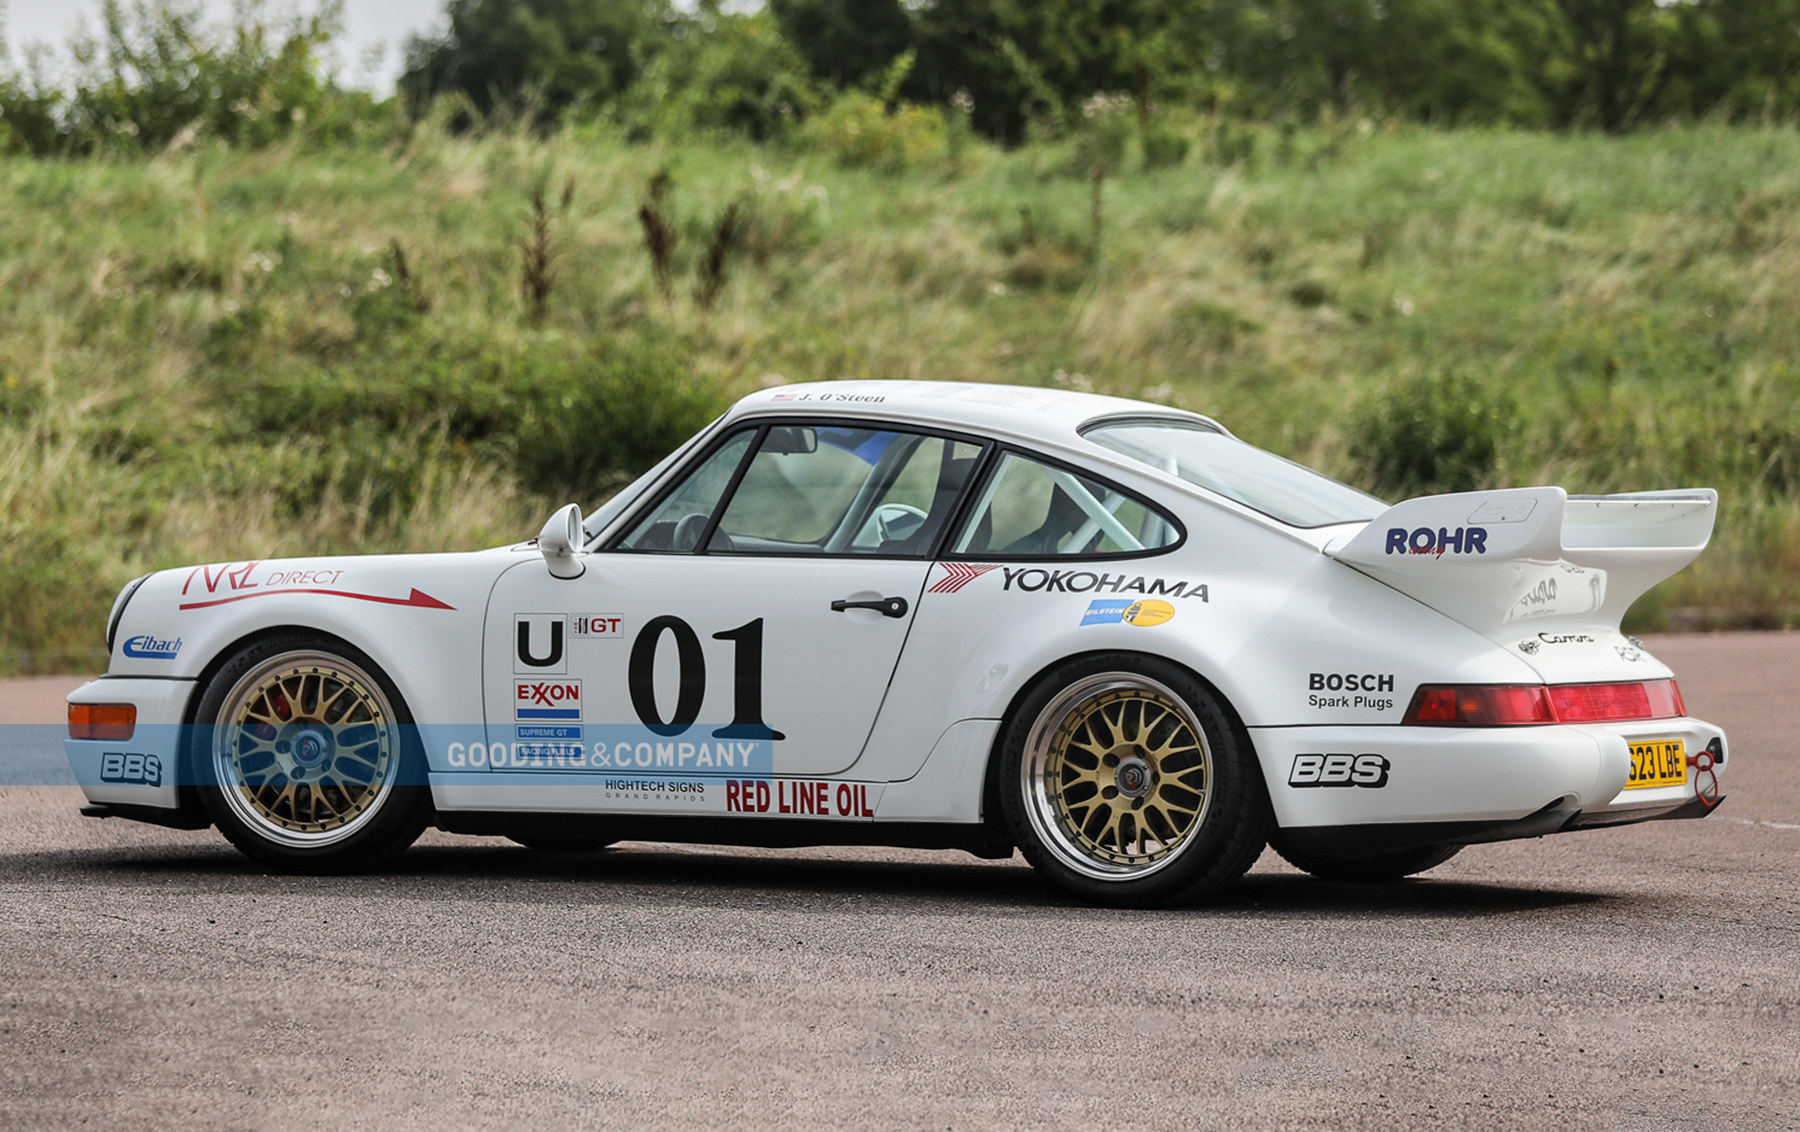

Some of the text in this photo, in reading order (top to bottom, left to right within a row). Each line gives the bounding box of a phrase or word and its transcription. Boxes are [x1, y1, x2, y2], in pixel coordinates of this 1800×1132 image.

[1385, 527, 1488, 555] ROHR
[265, 570, 344, 586] DIRECT
[1003, 567, 1209, 603] YOKOHAMA
[591, 618, 621, 633] GT
[123, 635, 183, 660] Eibach
[517, 621, 563, 667] U
[628, 615, 786, 741] 01
[1309, 673, 1394, 692] BOSCH
[517, 682, 579, 706] EXXON
[1308, 694, 1393, 711] Spark Plugs
[520, 728, 568, 737] SUPREME GT
[521, 746, 576, 756] RACING FUELS
[1657, 744, 1682, 778] LBE
[101, 752, 162, 787] BBS
[1288, 753, 1391, 788] BBS
[605, 779, 705, 793] HIGHTECH SIGNS
[605, 792, 705, 802] GRAND RAPIDS
[726, 780, 874, 818] RED LINE OIL
